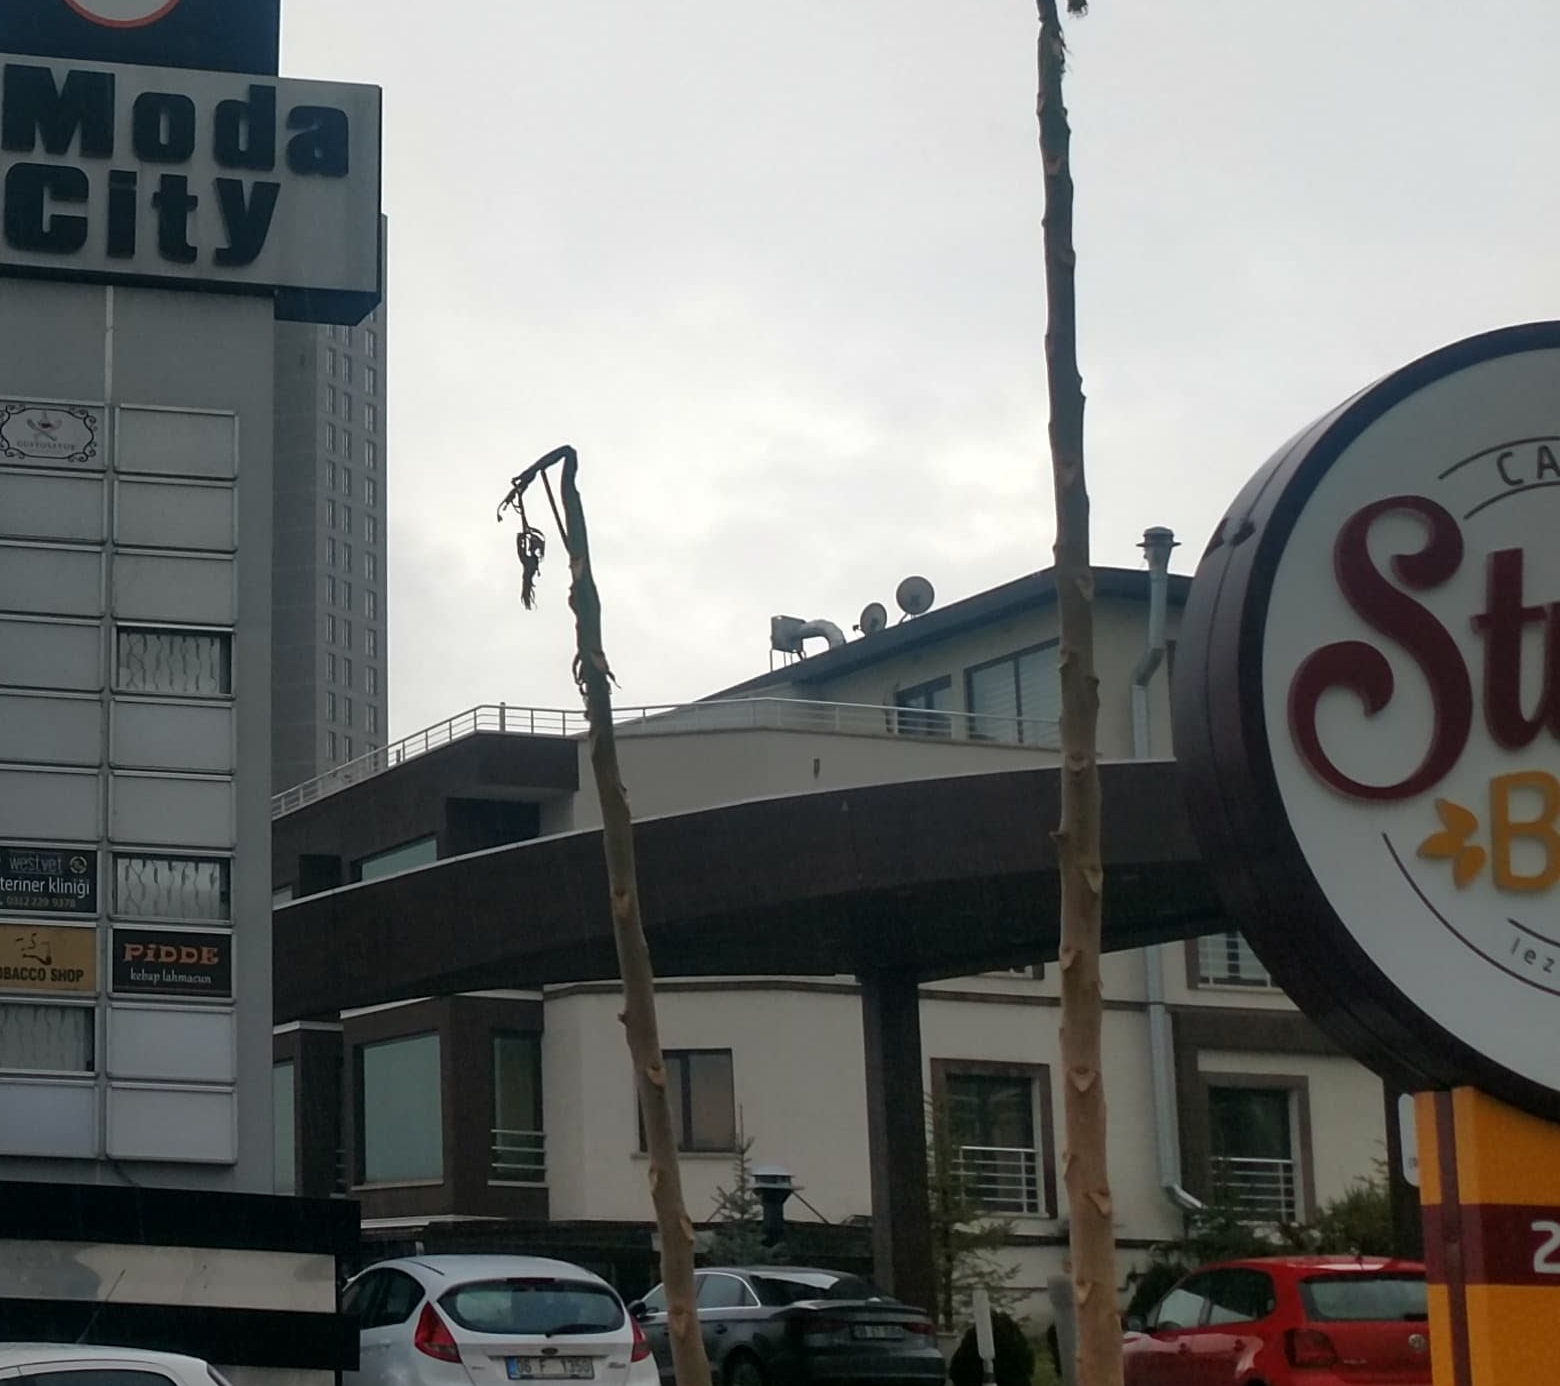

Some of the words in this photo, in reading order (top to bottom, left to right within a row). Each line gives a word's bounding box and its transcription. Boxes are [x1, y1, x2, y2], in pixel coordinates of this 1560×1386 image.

[1, 63, 350, 179] Moda
[2, 162, 282, 269] City
[1287, 494, 1560, 804] St
[48, 876, 90, 899] kliniği
[50, 968, 85, 983] SHOP
[130, 967, 161, 986] kebap
[162, 968, 212, 984] lahmacun
